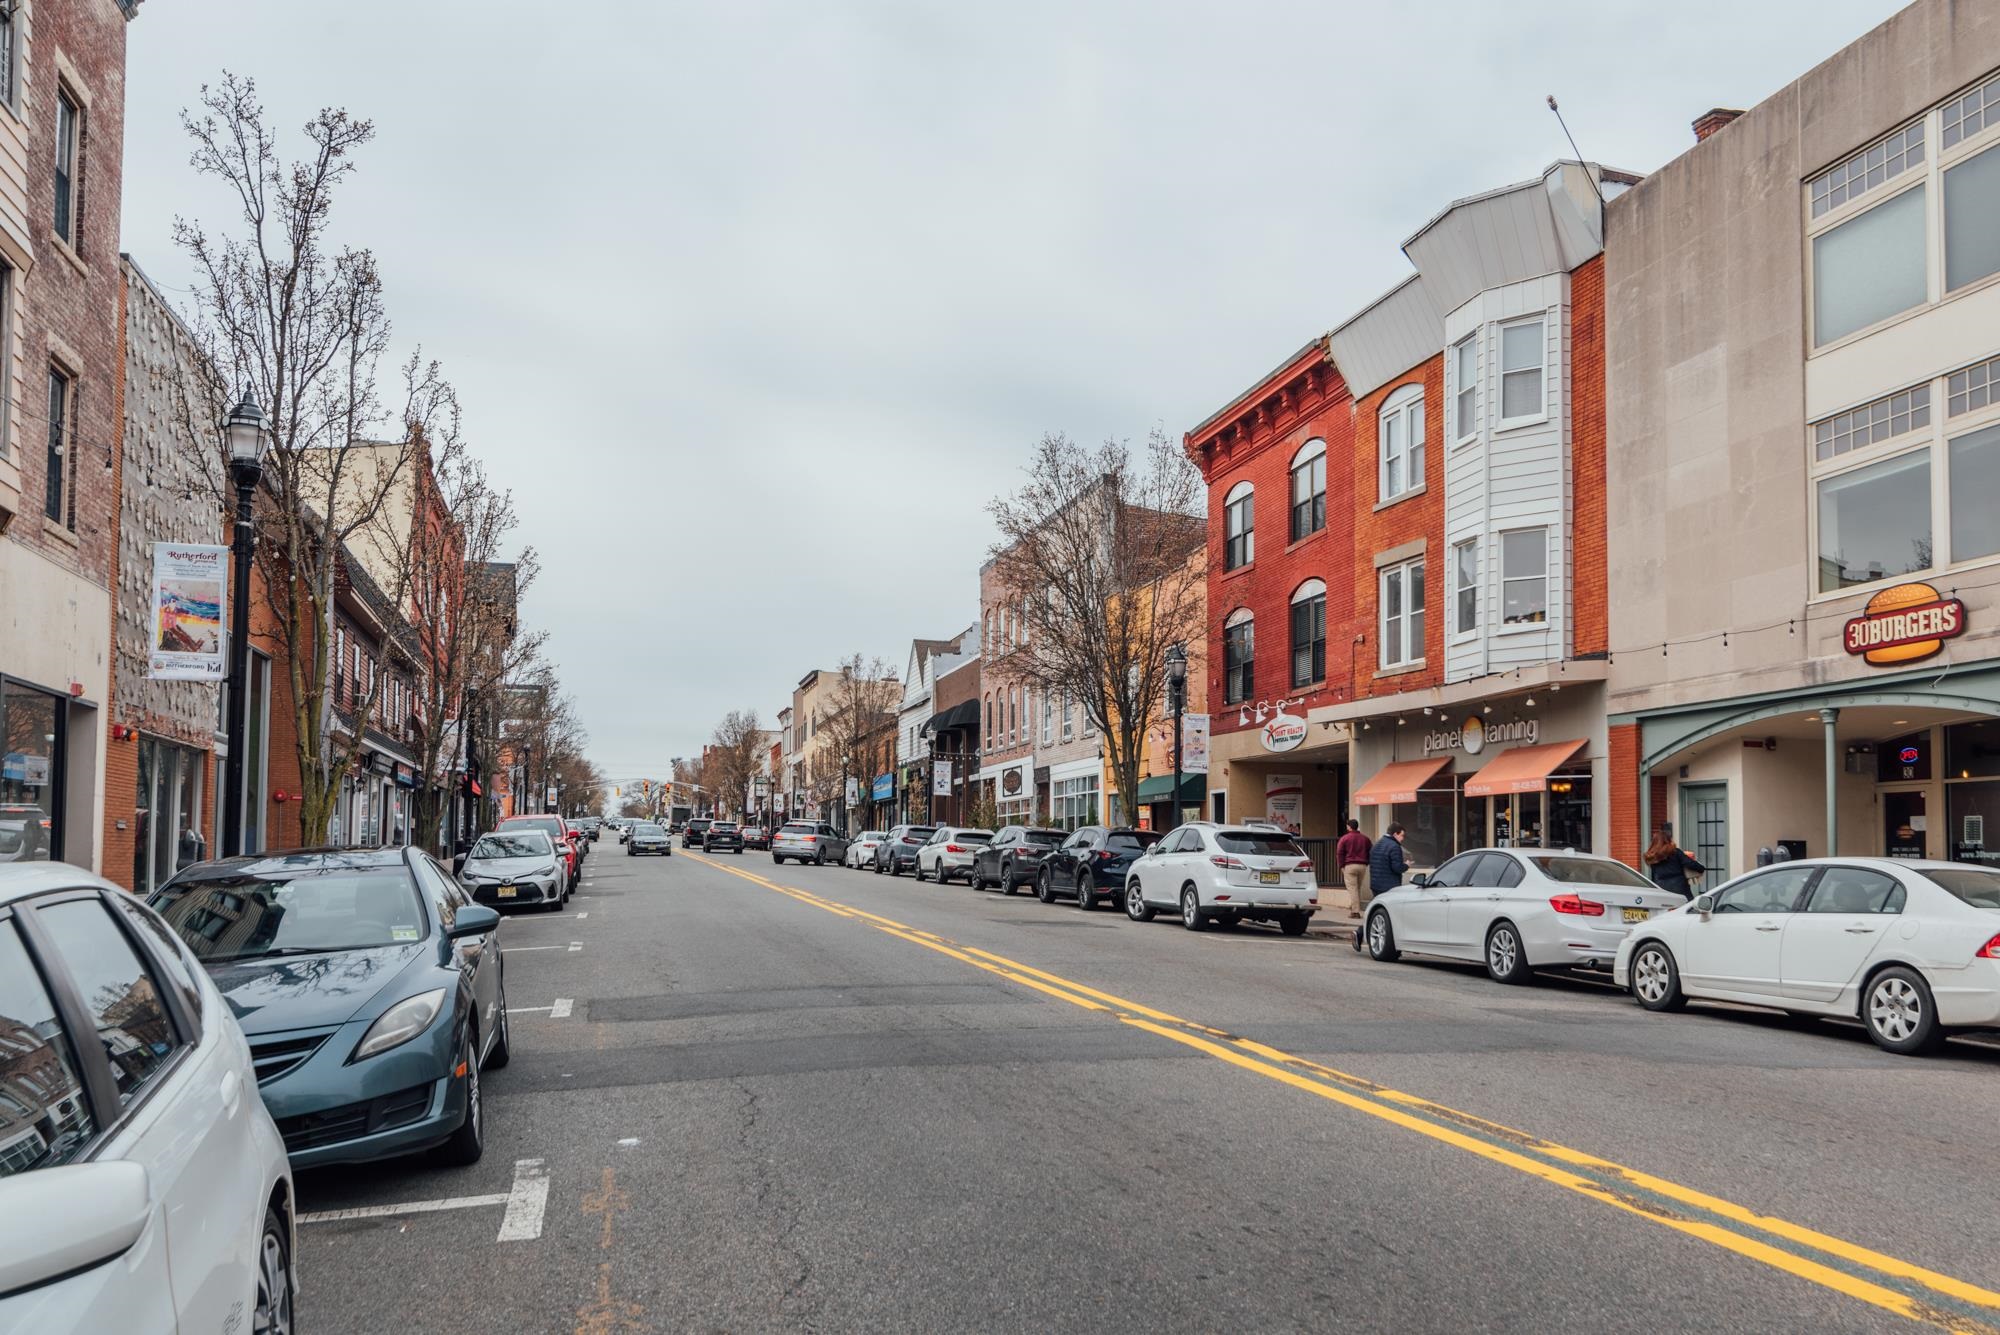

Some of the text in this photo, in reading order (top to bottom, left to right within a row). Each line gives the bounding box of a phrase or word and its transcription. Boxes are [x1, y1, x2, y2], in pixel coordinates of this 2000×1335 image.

[167, 551, 218, 562] Rutherford
[1424, 728, 1462, 756] planet
[1485, 719, 1539, 744] tanning
[1900, 750, 1918, 760] OPEN
